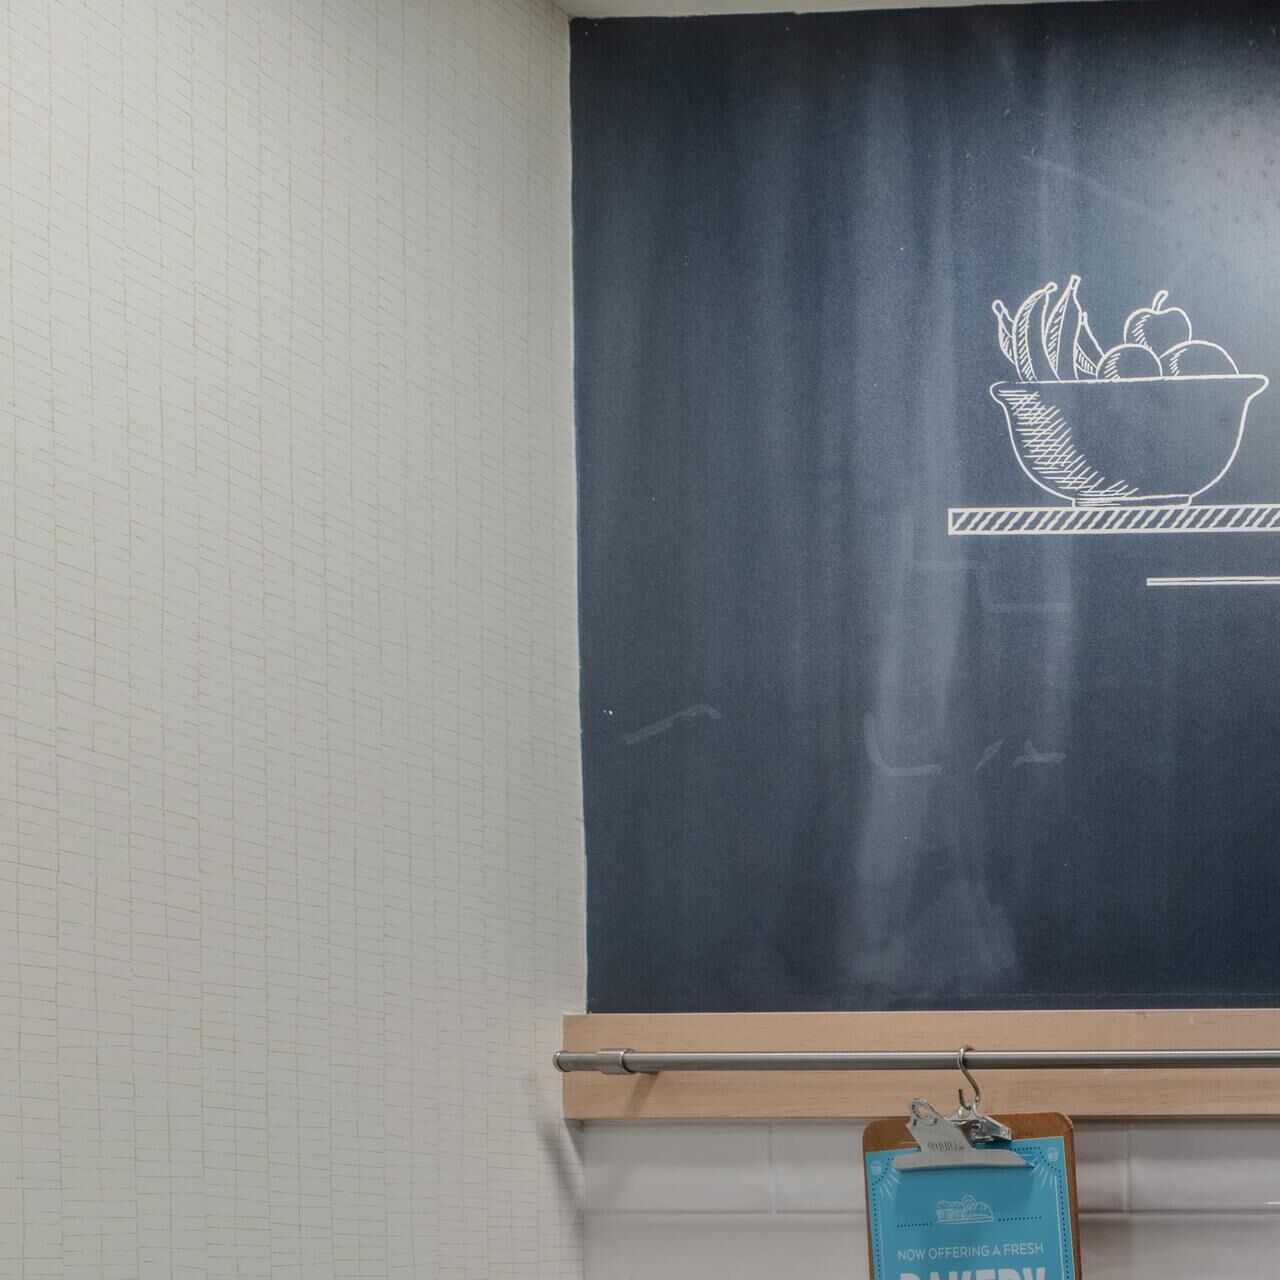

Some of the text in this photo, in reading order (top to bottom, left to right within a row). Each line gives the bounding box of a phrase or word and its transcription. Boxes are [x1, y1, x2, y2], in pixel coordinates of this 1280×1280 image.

[897, 1242, 1043, 1261] NOW OFFERING A FRESH
